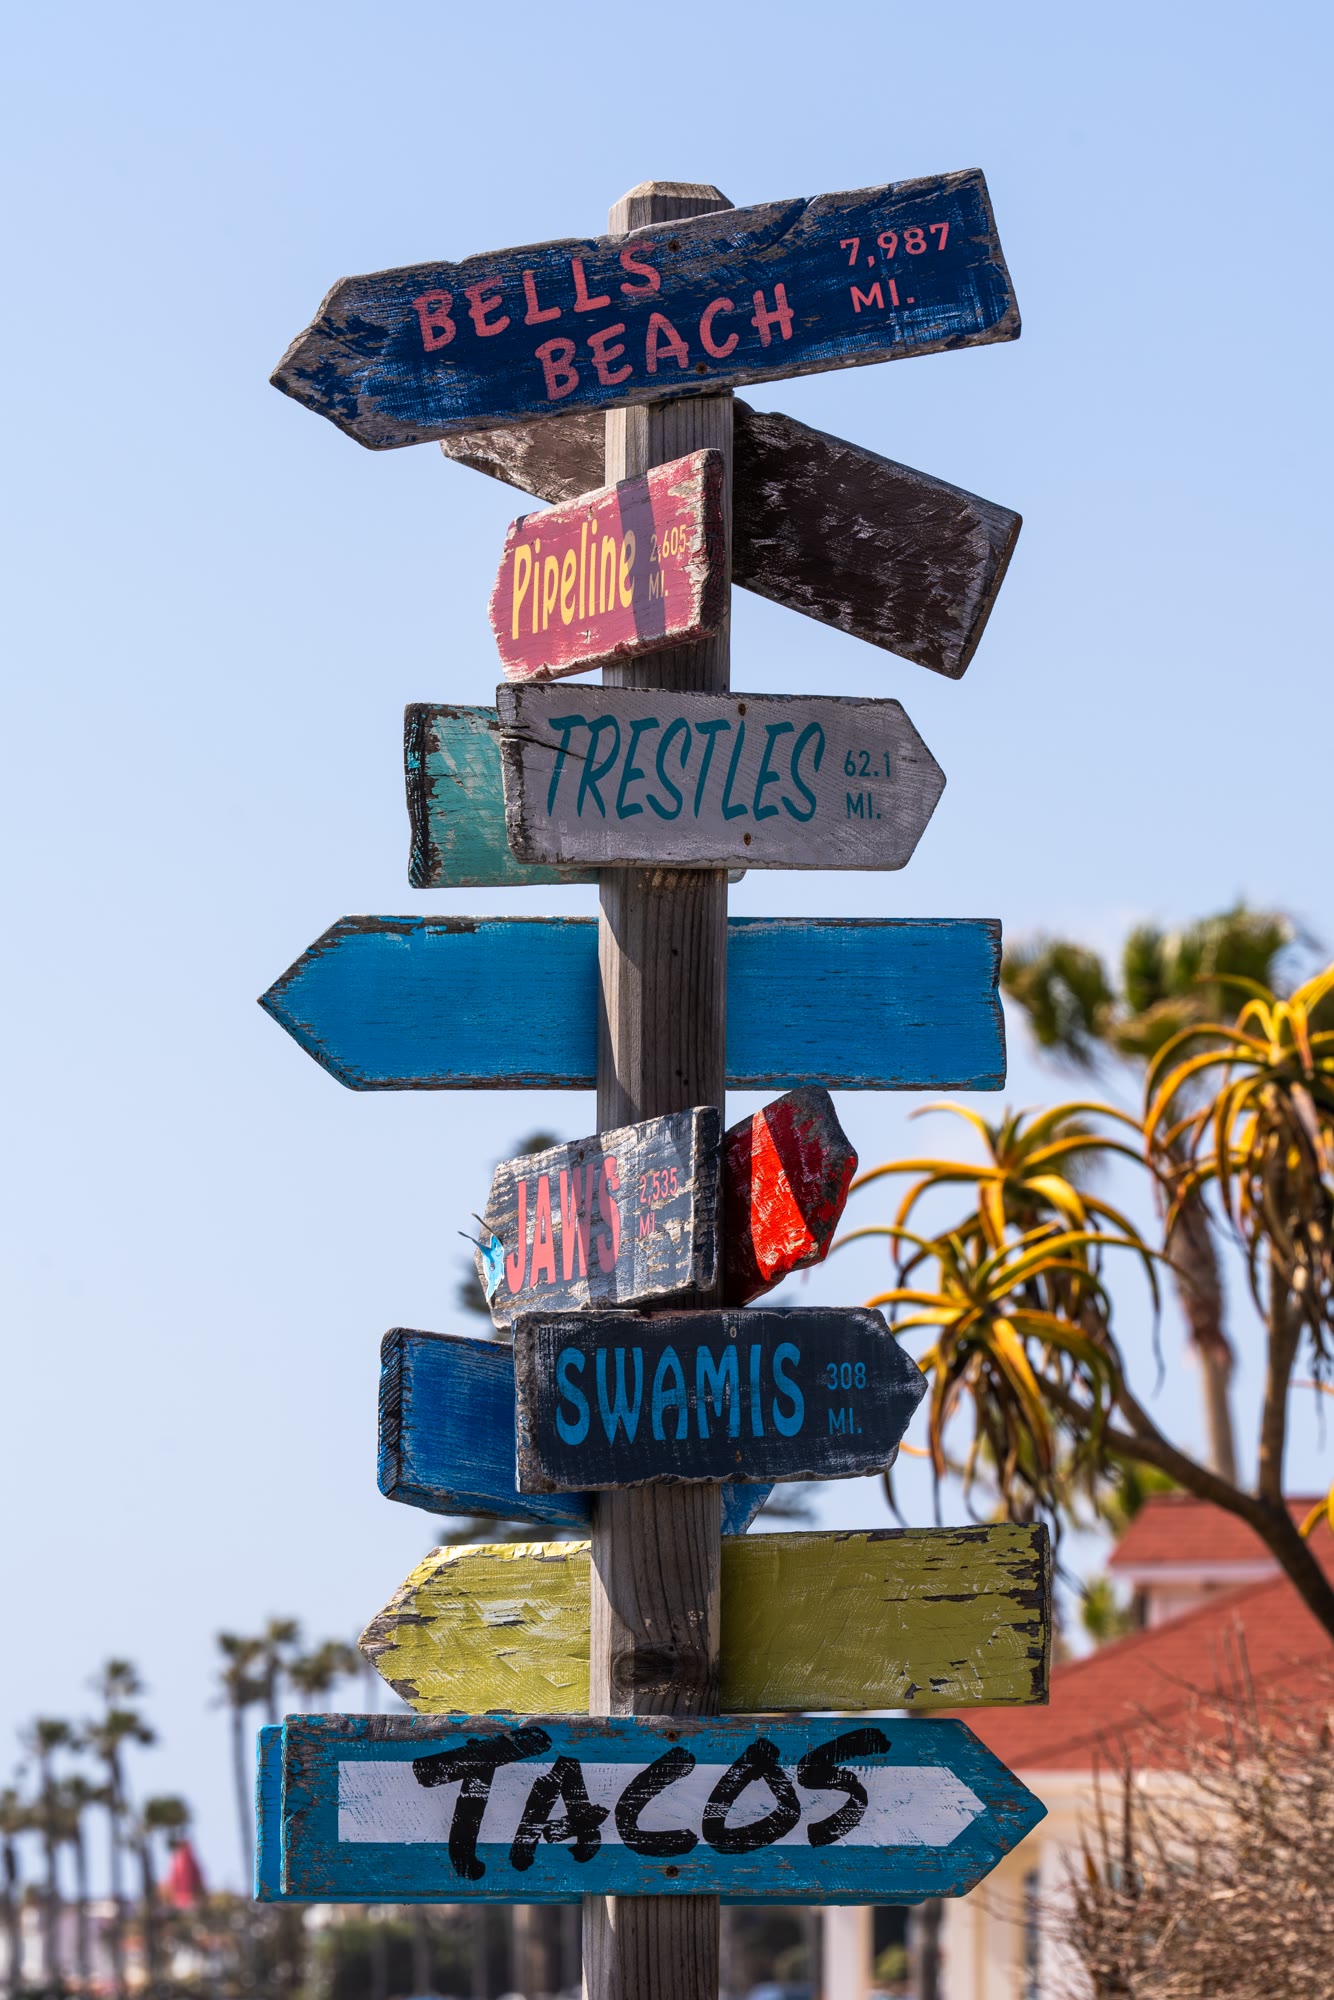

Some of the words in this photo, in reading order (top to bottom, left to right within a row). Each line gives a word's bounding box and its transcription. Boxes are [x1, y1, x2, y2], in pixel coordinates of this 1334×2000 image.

[839, 221, 951, 269] 7,987
[412, 242, 662, 352] BELLS
[850, 278, 915, 314] MI.
[534, 282, 795, 400] BEACH
[649, 524, 687, 563] 2,605
[511, 518, 637, 641] Pipeline
[648, 569, 669, 601] MI.
[547, 714, 827, 823] TRESTLES
[844, 749, 892, 778] 62.1
[847, 792, 882, 820] MI.
[638, 1166, 679, 1206] 2,535
[506, 1156, 620, 1294] JAWS
[555, 1341, 805, 1446] SWAMIS
[826, 1361, 867, 1391] 308
[828, 1407, 862, 1435] MI.
[411, 1725, 893, 1882] TACOS
